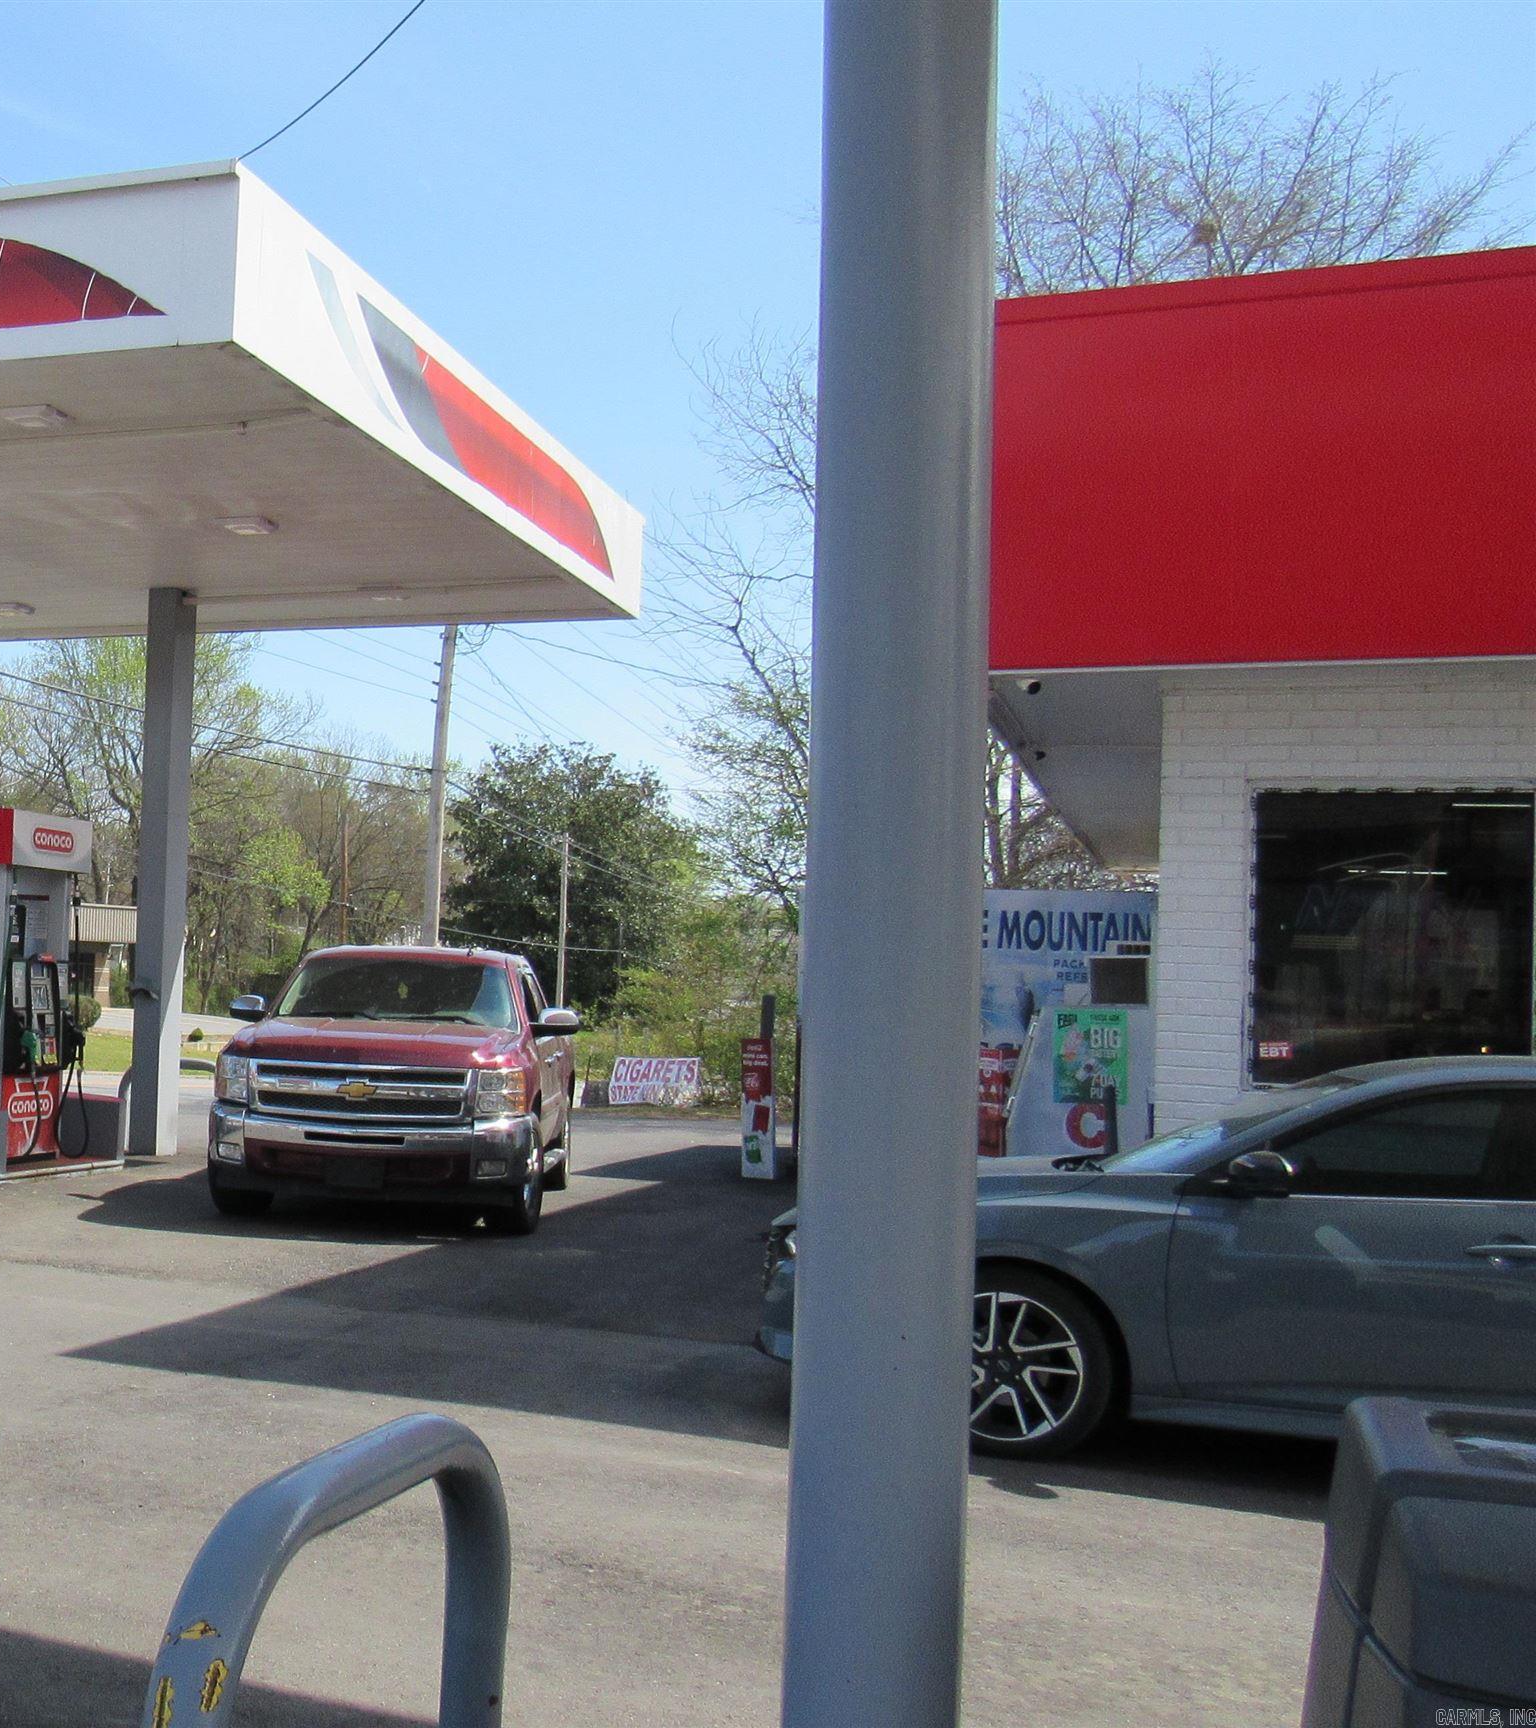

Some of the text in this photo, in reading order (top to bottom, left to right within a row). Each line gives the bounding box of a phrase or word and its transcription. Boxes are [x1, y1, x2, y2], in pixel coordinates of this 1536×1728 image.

[997, 909, 1152, 952] MOUNTAIN
[1090, 1027, 1121, 1049] BIG
[1259, 1046, 1289, 1057] EBT
[614, 1058, 697, 1084] CIGARETS
[610, 1085, 640, 1102] STATE
